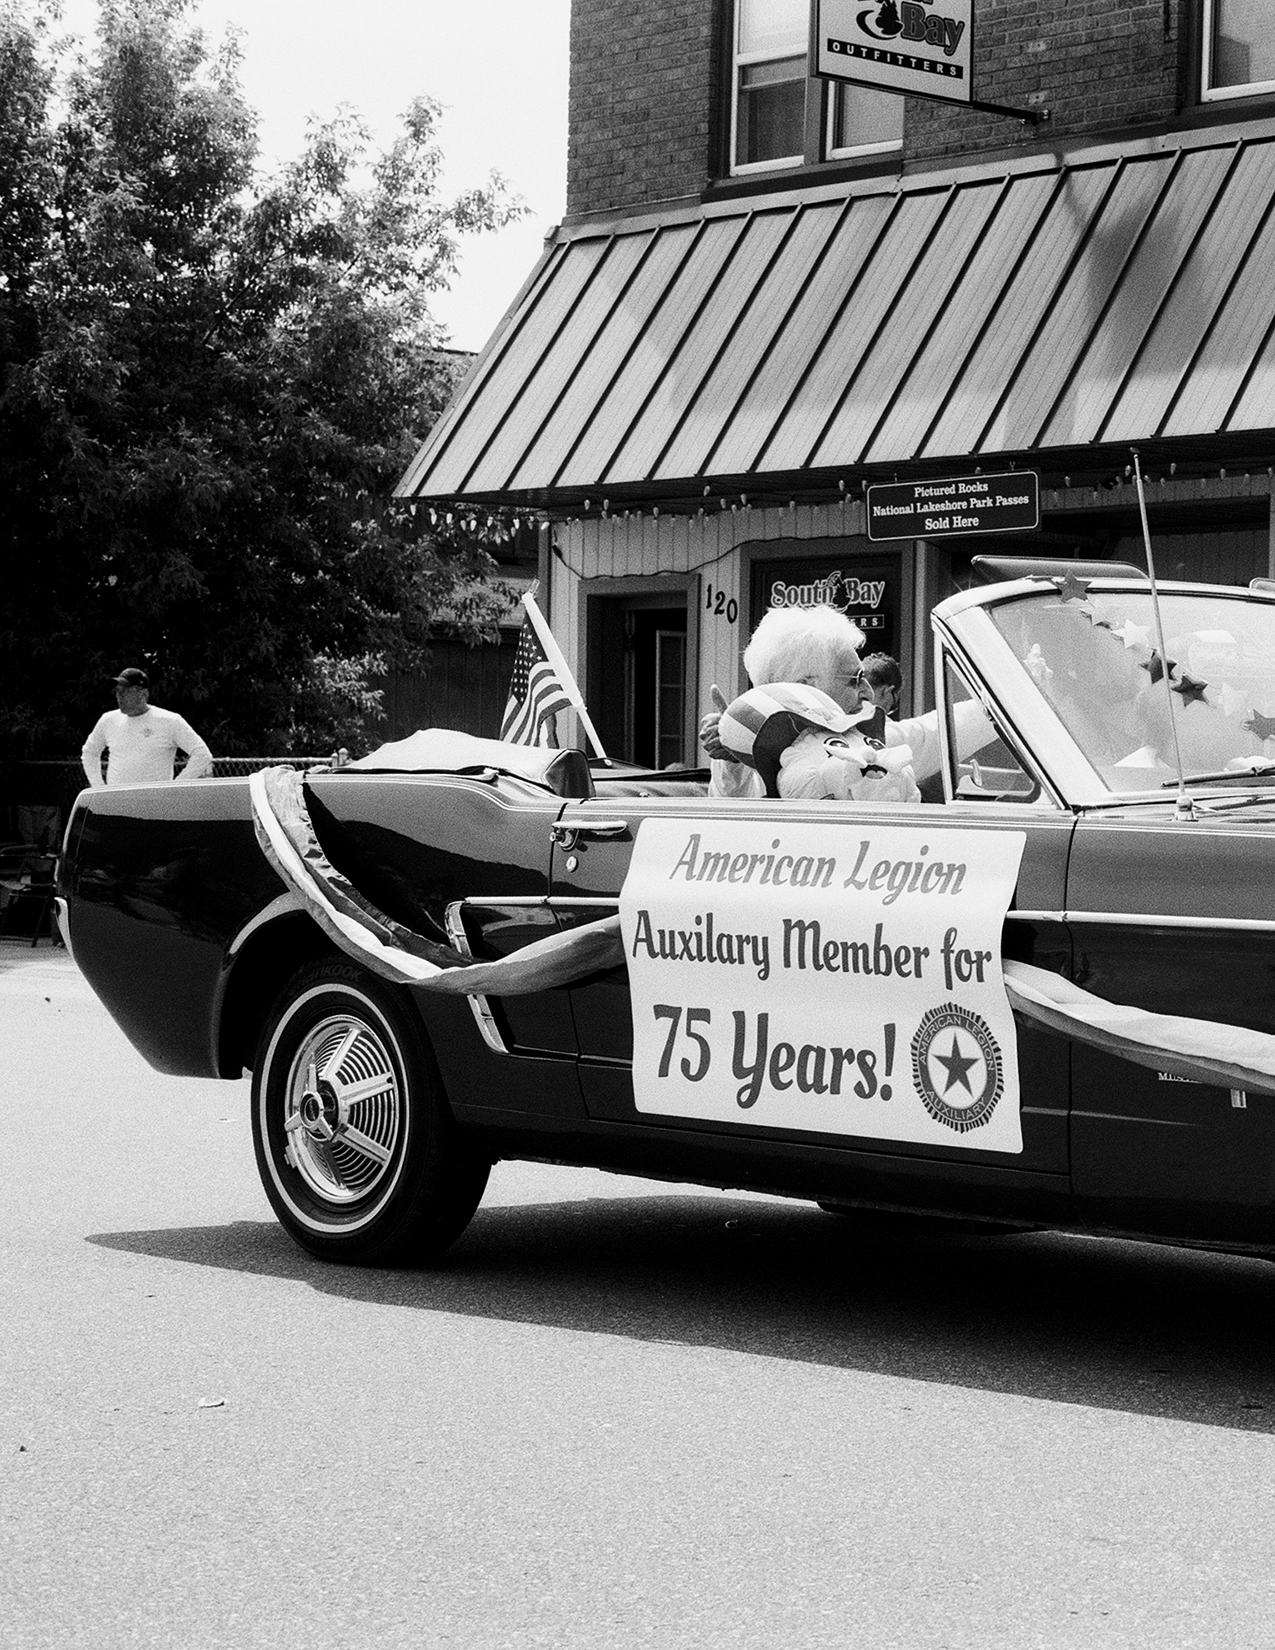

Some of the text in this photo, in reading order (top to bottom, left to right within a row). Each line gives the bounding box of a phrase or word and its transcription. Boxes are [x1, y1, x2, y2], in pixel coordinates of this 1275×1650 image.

[901, 1, 965, 56] Bay
[832, 42, 957, 76] OUTFITTERS
[873, 495, 1029, 517] National Lakeshore Park Passes
[914, 482, 988, 498] Pictured Rocks
[925, 515, 980, 530] Sold Here
[706, 583, 738, 624] 120
[771, 578, 885, 608] South Bay
[669, 833, 967, 905] American Legion
[632, 910, 992, 991] Auxilary Member for
[652, 1004, 896, 1110] 75 Years!
[919, 1015, 995, 1071] AMERICAN LEGION
[926, 1090, 986, 1120] AUXILIARY
